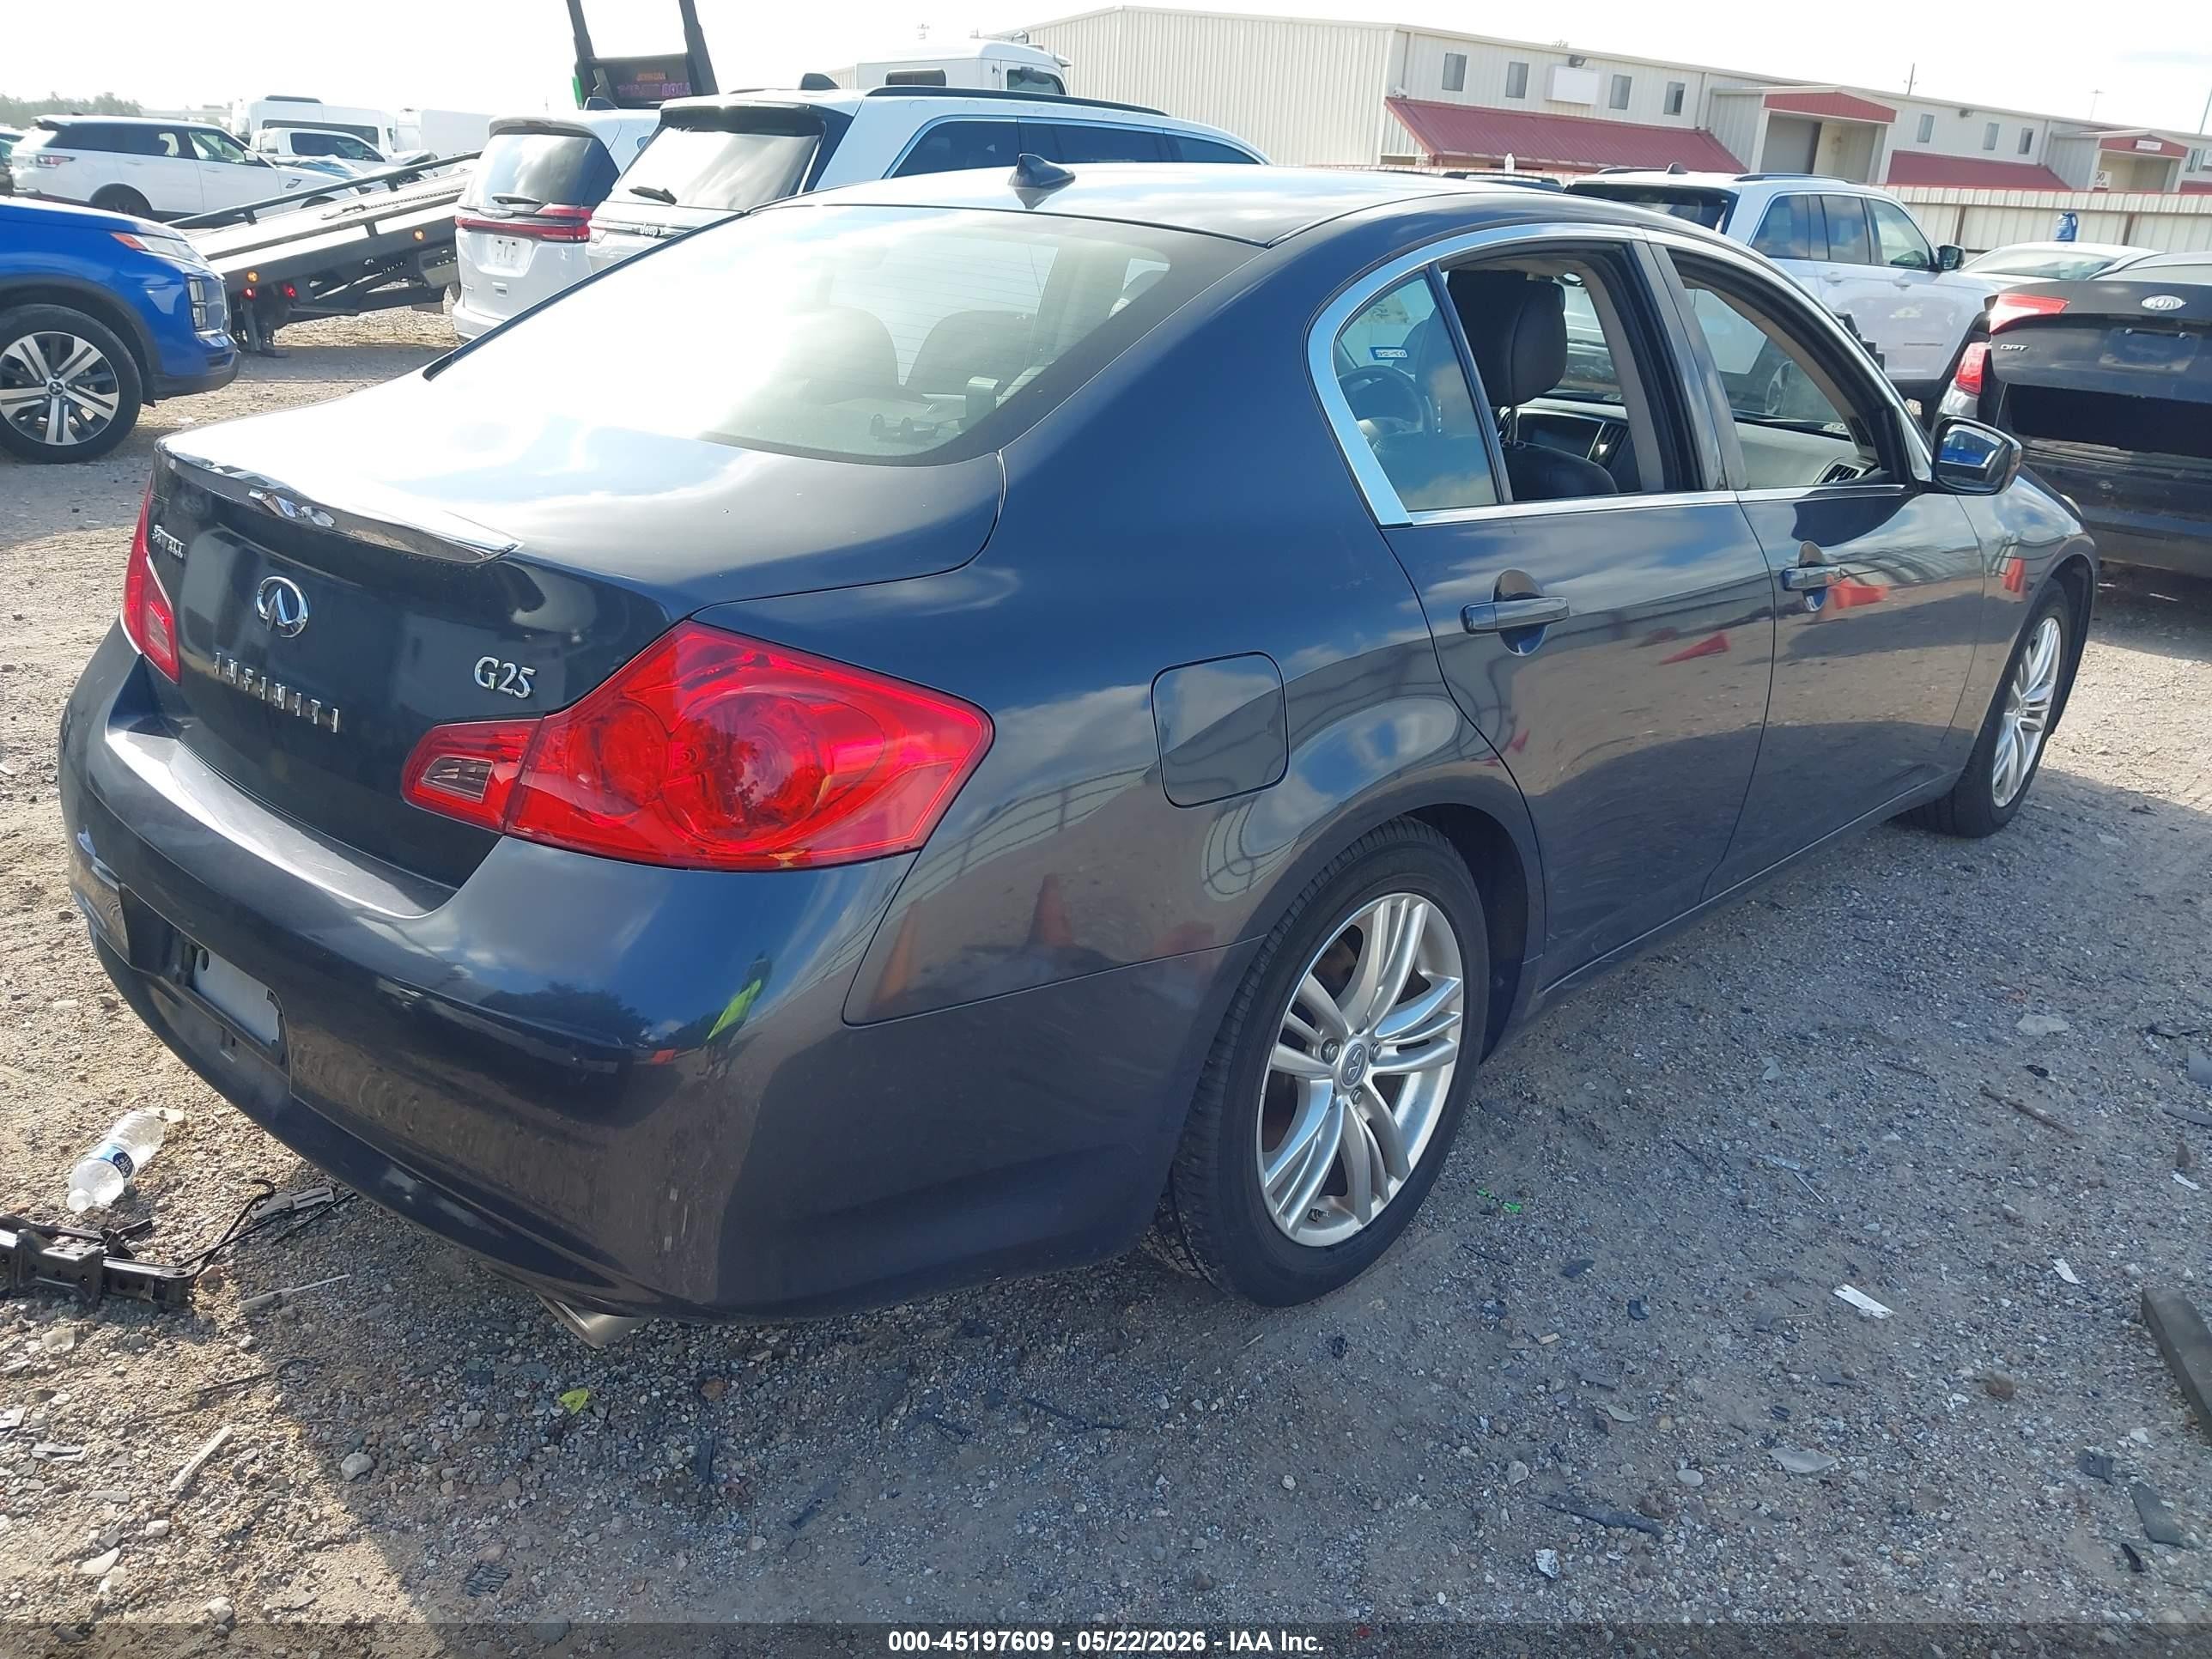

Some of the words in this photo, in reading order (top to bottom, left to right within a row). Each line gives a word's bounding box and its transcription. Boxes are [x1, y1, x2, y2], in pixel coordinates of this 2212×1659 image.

[640, 223, 659, 237] Jeep
[1999, 343, 2028, 352] OPT
[474, 656, 537, 699] G25
[214, 652, 340, 734] INFINITI
